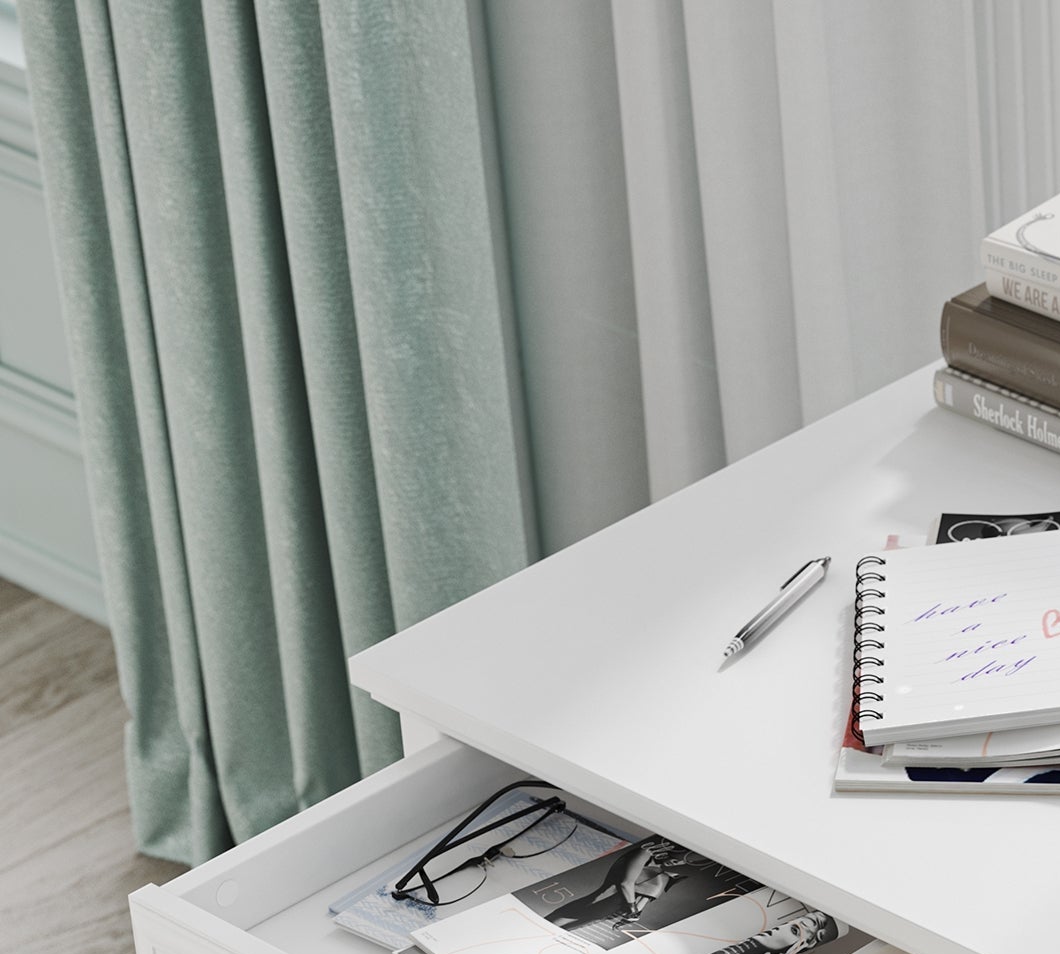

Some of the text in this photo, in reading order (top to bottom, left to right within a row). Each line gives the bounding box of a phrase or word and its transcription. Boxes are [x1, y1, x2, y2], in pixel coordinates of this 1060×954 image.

[987, 254, 1005, 267] THE
[1008, 261, 1026, 273] BIG
[1030, 267, 1058, 283] SLEEP
[1002, 277, 1022, 300] WE
[1025, 286, 1049, 311] ARE
[973, 394, 1024, 435] Sherlock
[940, 635, 1026, 662] nice
[955, 656, 1037, 682] day
[532, 882, 575, 905] 15
